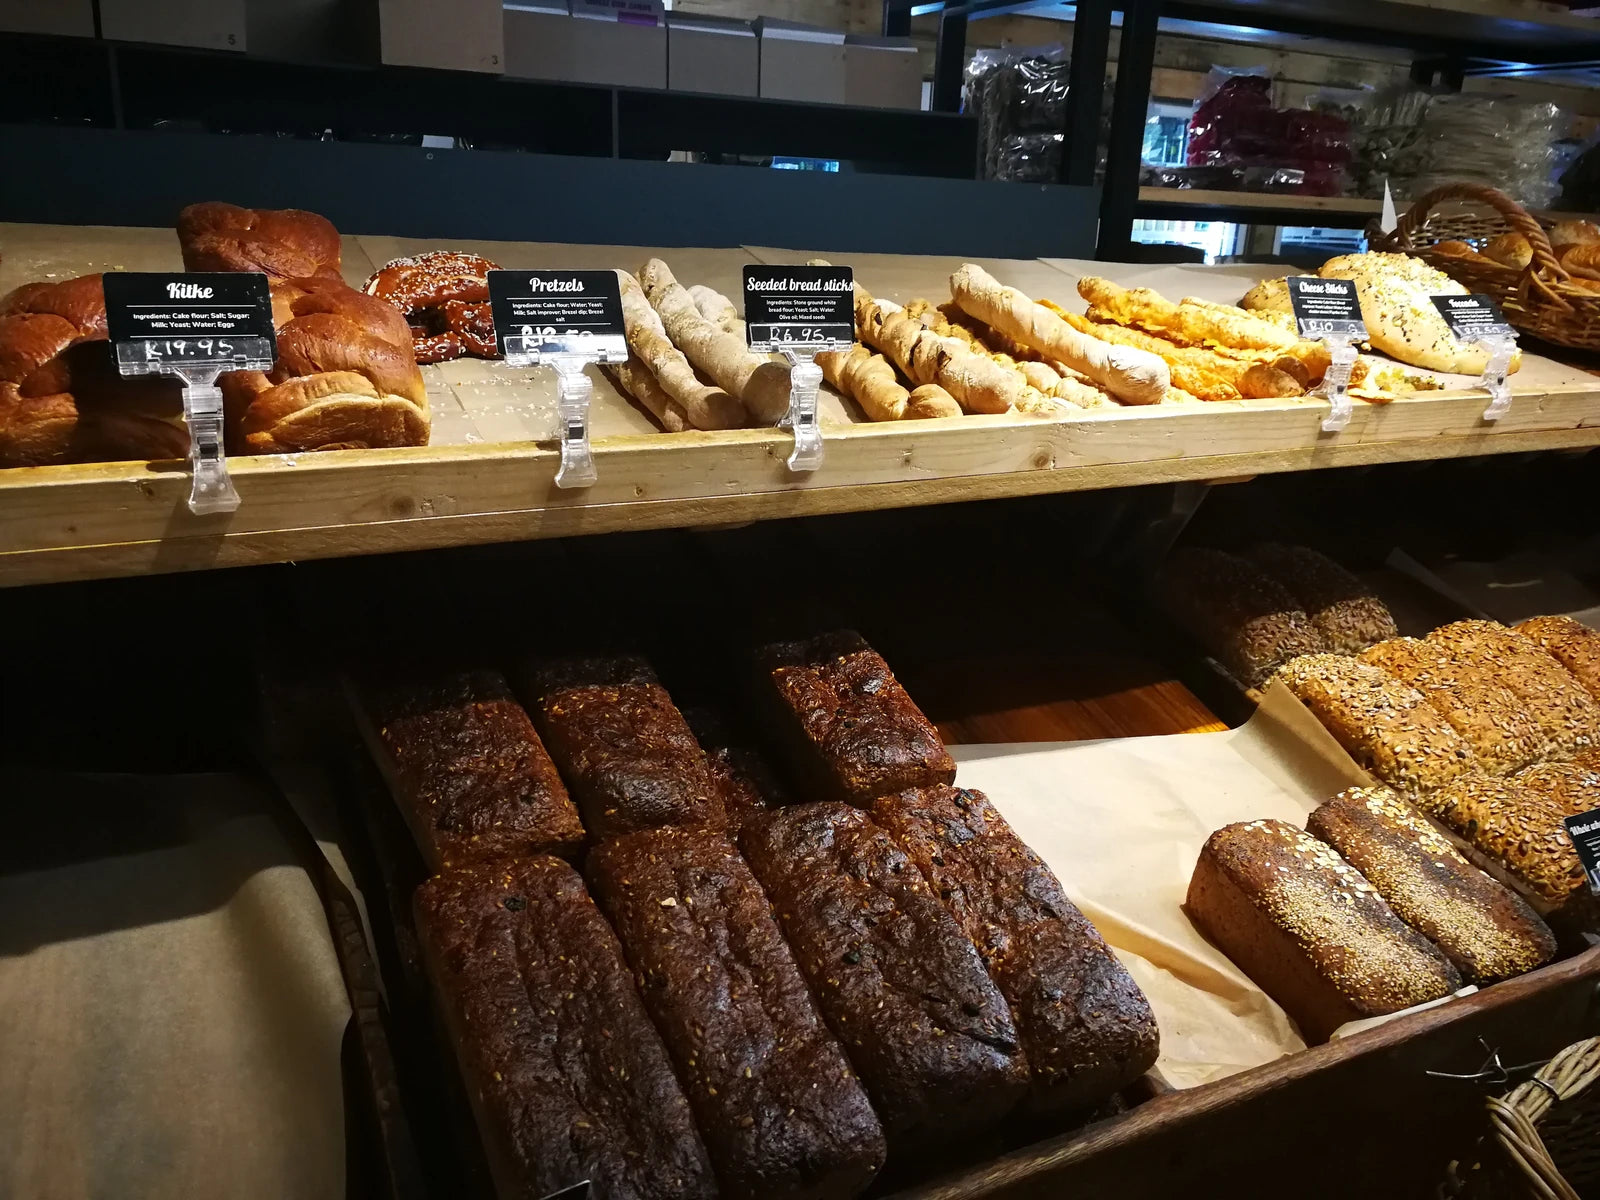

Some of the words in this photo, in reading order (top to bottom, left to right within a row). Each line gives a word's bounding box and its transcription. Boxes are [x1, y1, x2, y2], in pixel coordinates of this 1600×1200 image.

[166, 282, 214, 299] Kitke
[529, 277, 585, 292] Pretzels
[747, 277, 788, 291] Seeded
[789, 278, 822, 291] bread
[823, 278, 854, 292] sticks
[1299, 281, 1324, 293] Cheese
[1325, 283, 1348, 295] Sticks
[217, 321, 235, 329] Eggs
